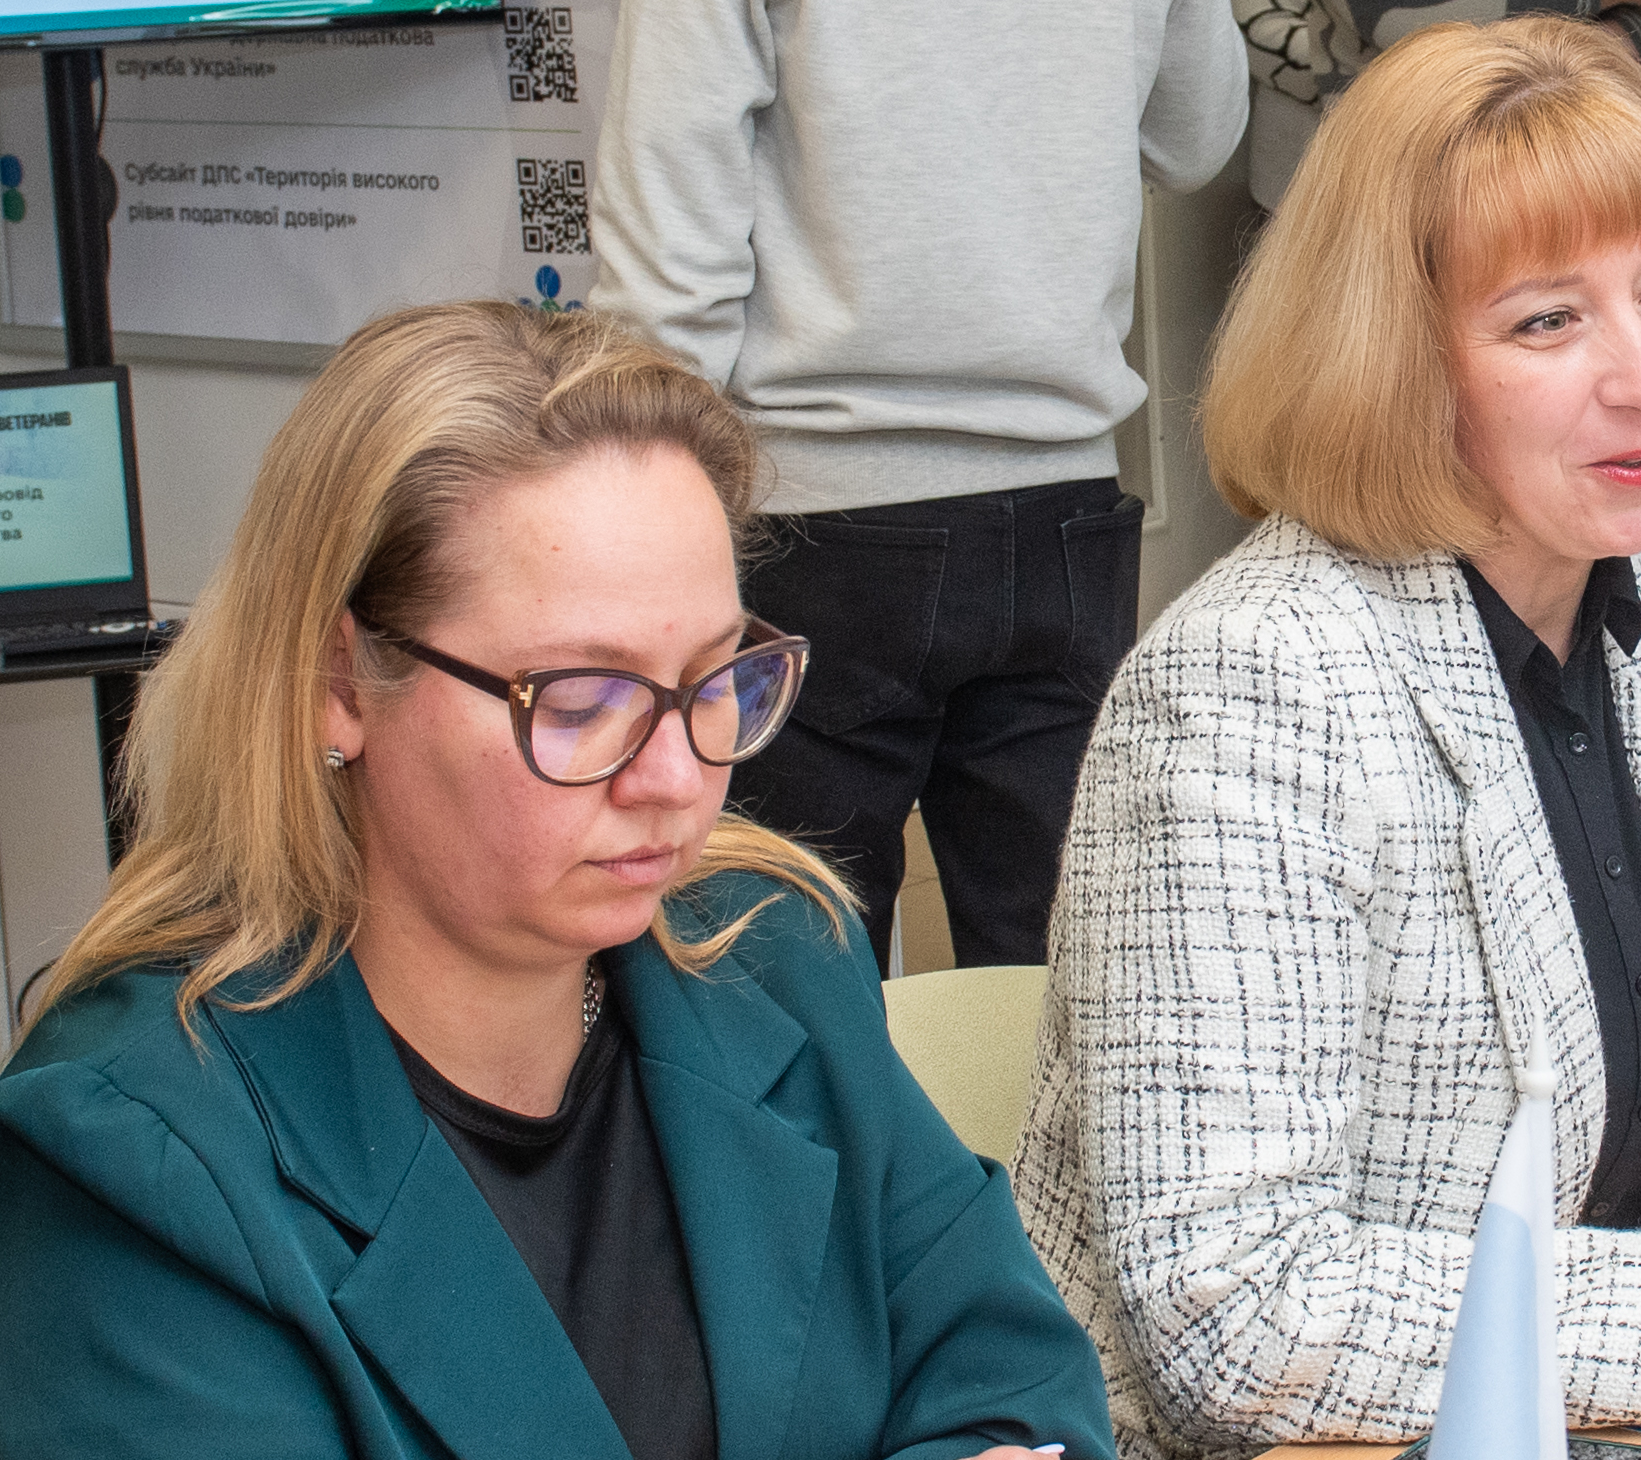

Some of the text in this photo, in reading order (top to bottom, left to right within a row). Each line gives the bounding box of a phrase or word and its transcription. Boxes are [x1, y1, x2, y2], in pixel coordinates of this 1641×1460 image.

[115, 55, 276, 80] служба України»
[123, 161, 441, 192] Субсайт ДПС «Територія високого
[127, 201, 357, 233] рівня податкової довіри»
